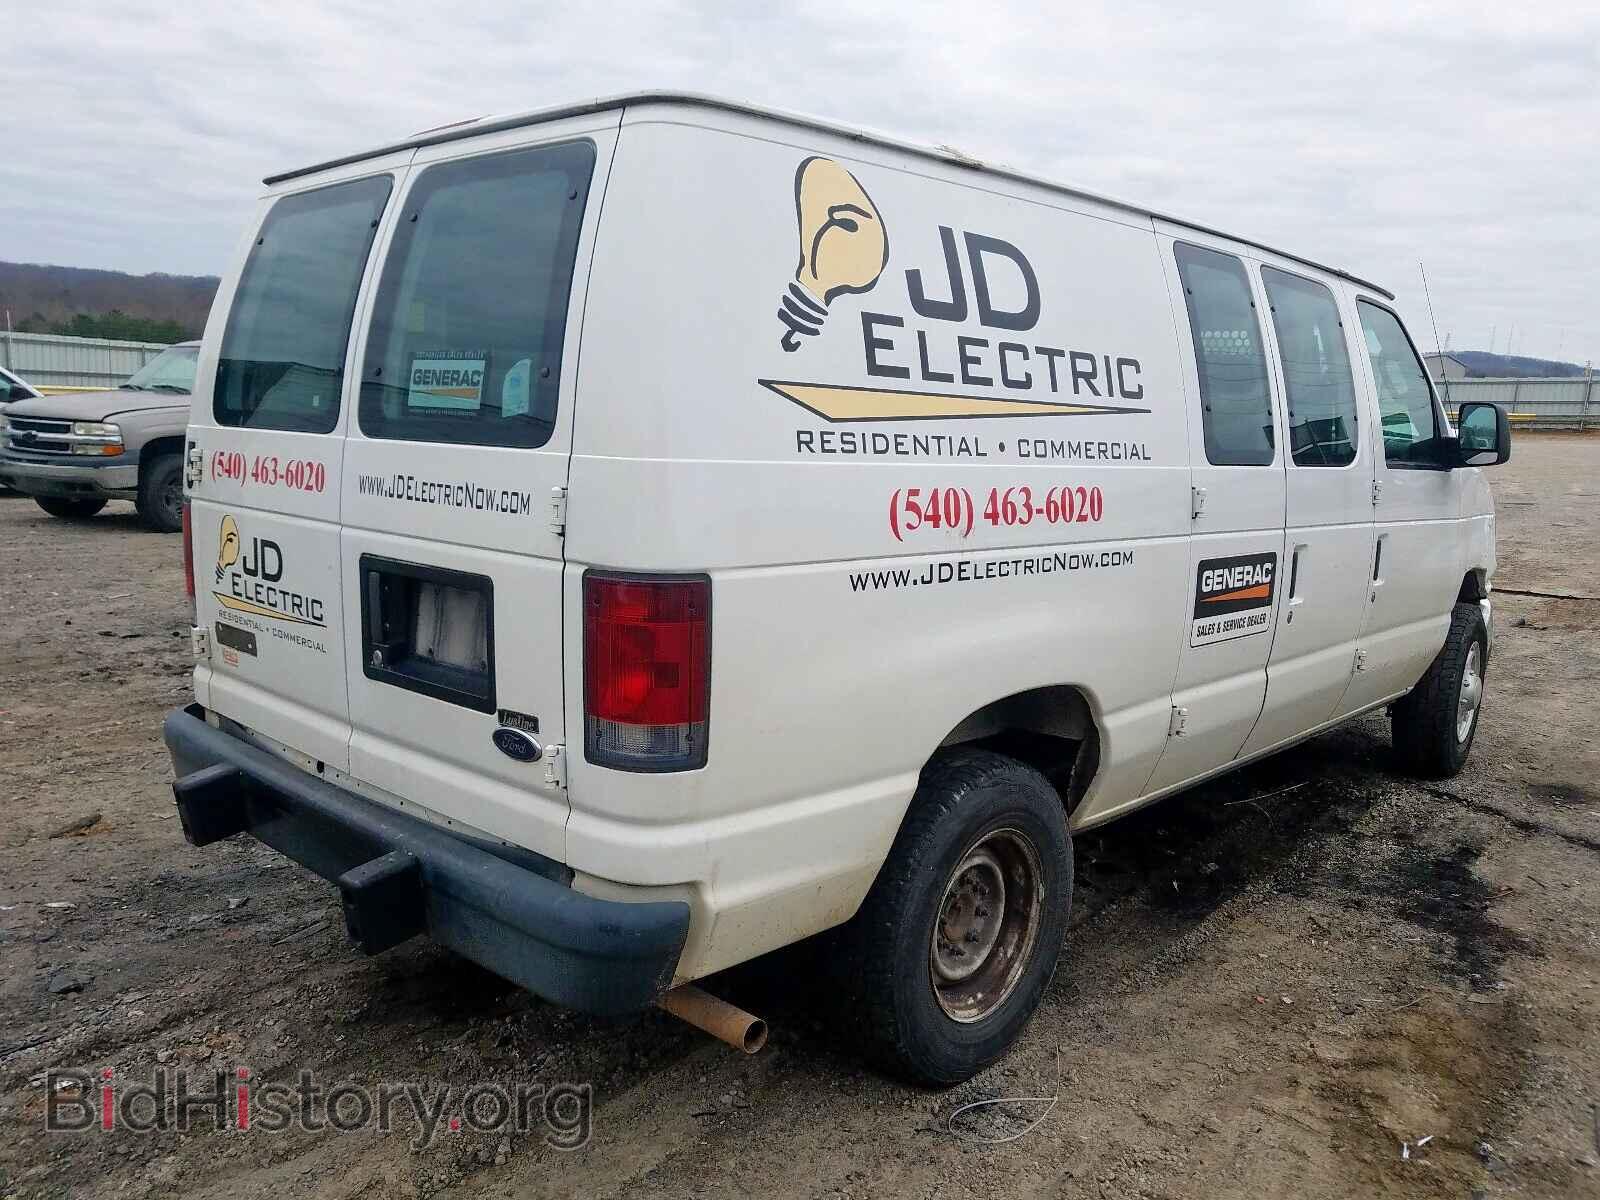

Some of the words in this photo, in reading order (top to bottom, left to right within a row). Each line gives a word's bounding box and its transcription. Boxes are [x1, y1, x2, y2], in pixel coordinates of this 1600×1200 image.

[905, 224, 1041, 332] JD
[412, 368, 482, 387] GENERAC
[860, 311, 1144, 400] ELECTRIC
[796, 429, 988, 458] RESIDENTIAL
[1017, 438, 1152, 461] COMMERCIAL
[211, 450, 247, 487] (540)
[251, 455, 326, 493] 463-6020
[888, 486, 975, 542] (540)
[983, 485, 1104, 526] 463-6020
[242, 536, 283, 583] JD
[1201, 562, 1272, 593] GENERAC
[231, 572, 324, 622] ELECTRIC
[218, 609, 264, 633] RESIDENTIAL
[272, 627, 327, 654] COMMERCIAL
[1196, 622, 1216, 638] SALES
[1216, 619, 1221, 634] &
[1222, 616, 1247, 633] SERVICE
[1246, 612, 1267, 628] DEALER
[502, 733, 528, 754] Ford
